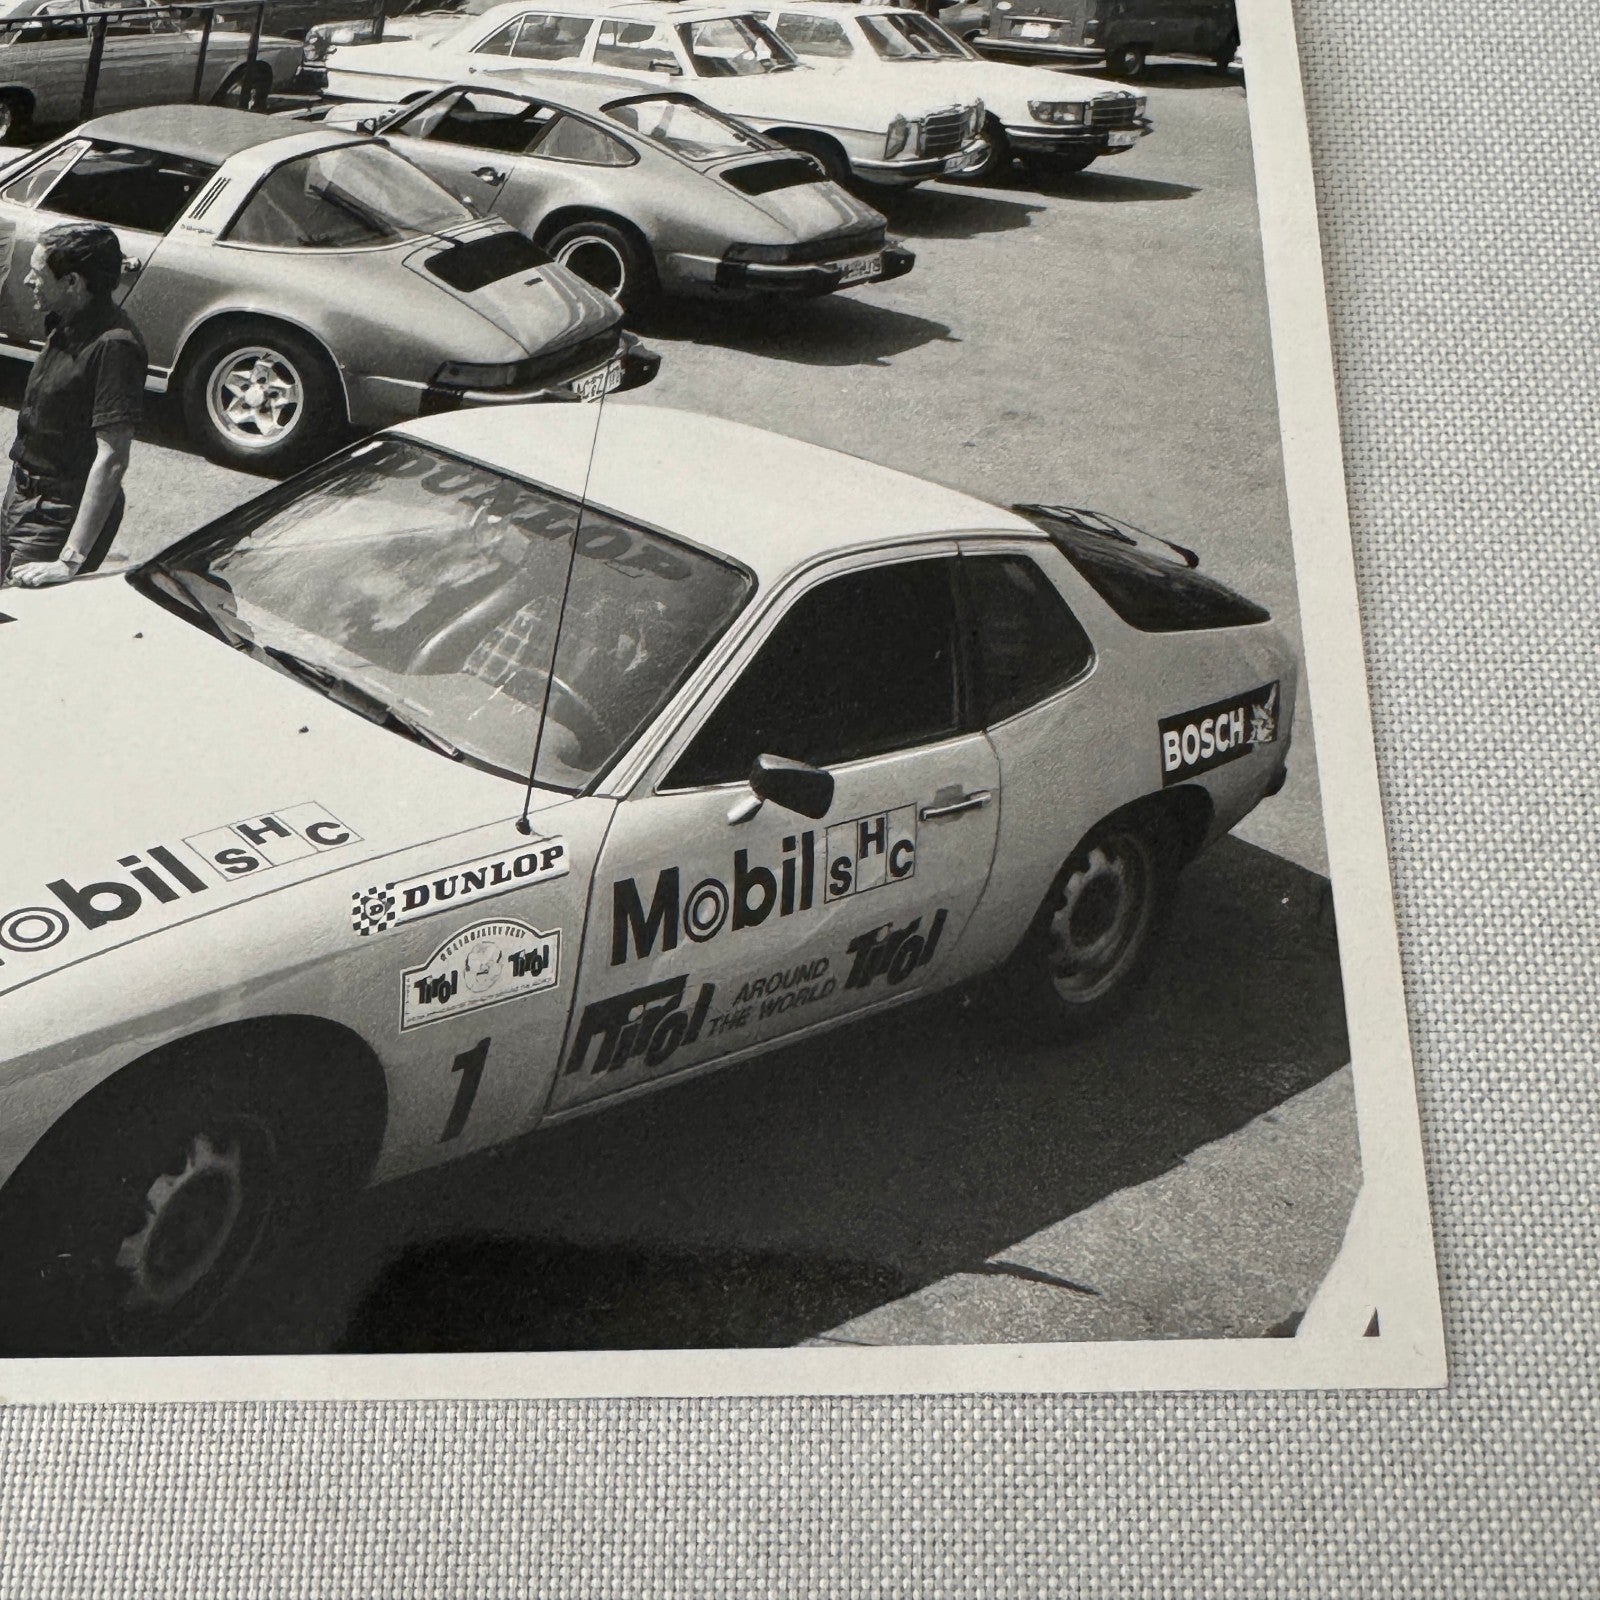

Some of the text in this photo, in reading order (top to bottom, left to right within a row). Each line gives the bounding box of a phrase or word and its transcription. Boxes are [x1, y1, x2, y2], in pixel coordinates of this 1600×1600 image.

[1163, 707, 1244, 771] BOSCH
[0, 845, 208, 966] obil
[402, 845, 564, 912] DUNLOP
[610, 830, 815, 966] Mobil
[414, 970, 458, 1004] Tirol
[508, 944, 549, 977] Tirol
[732, 957, 830, 1007] AROUND
[844, 908, 948, 990] Tirol
[707, 977, 837, 1037] THE WORLD
[440, 1037, 491, 1143] 1
